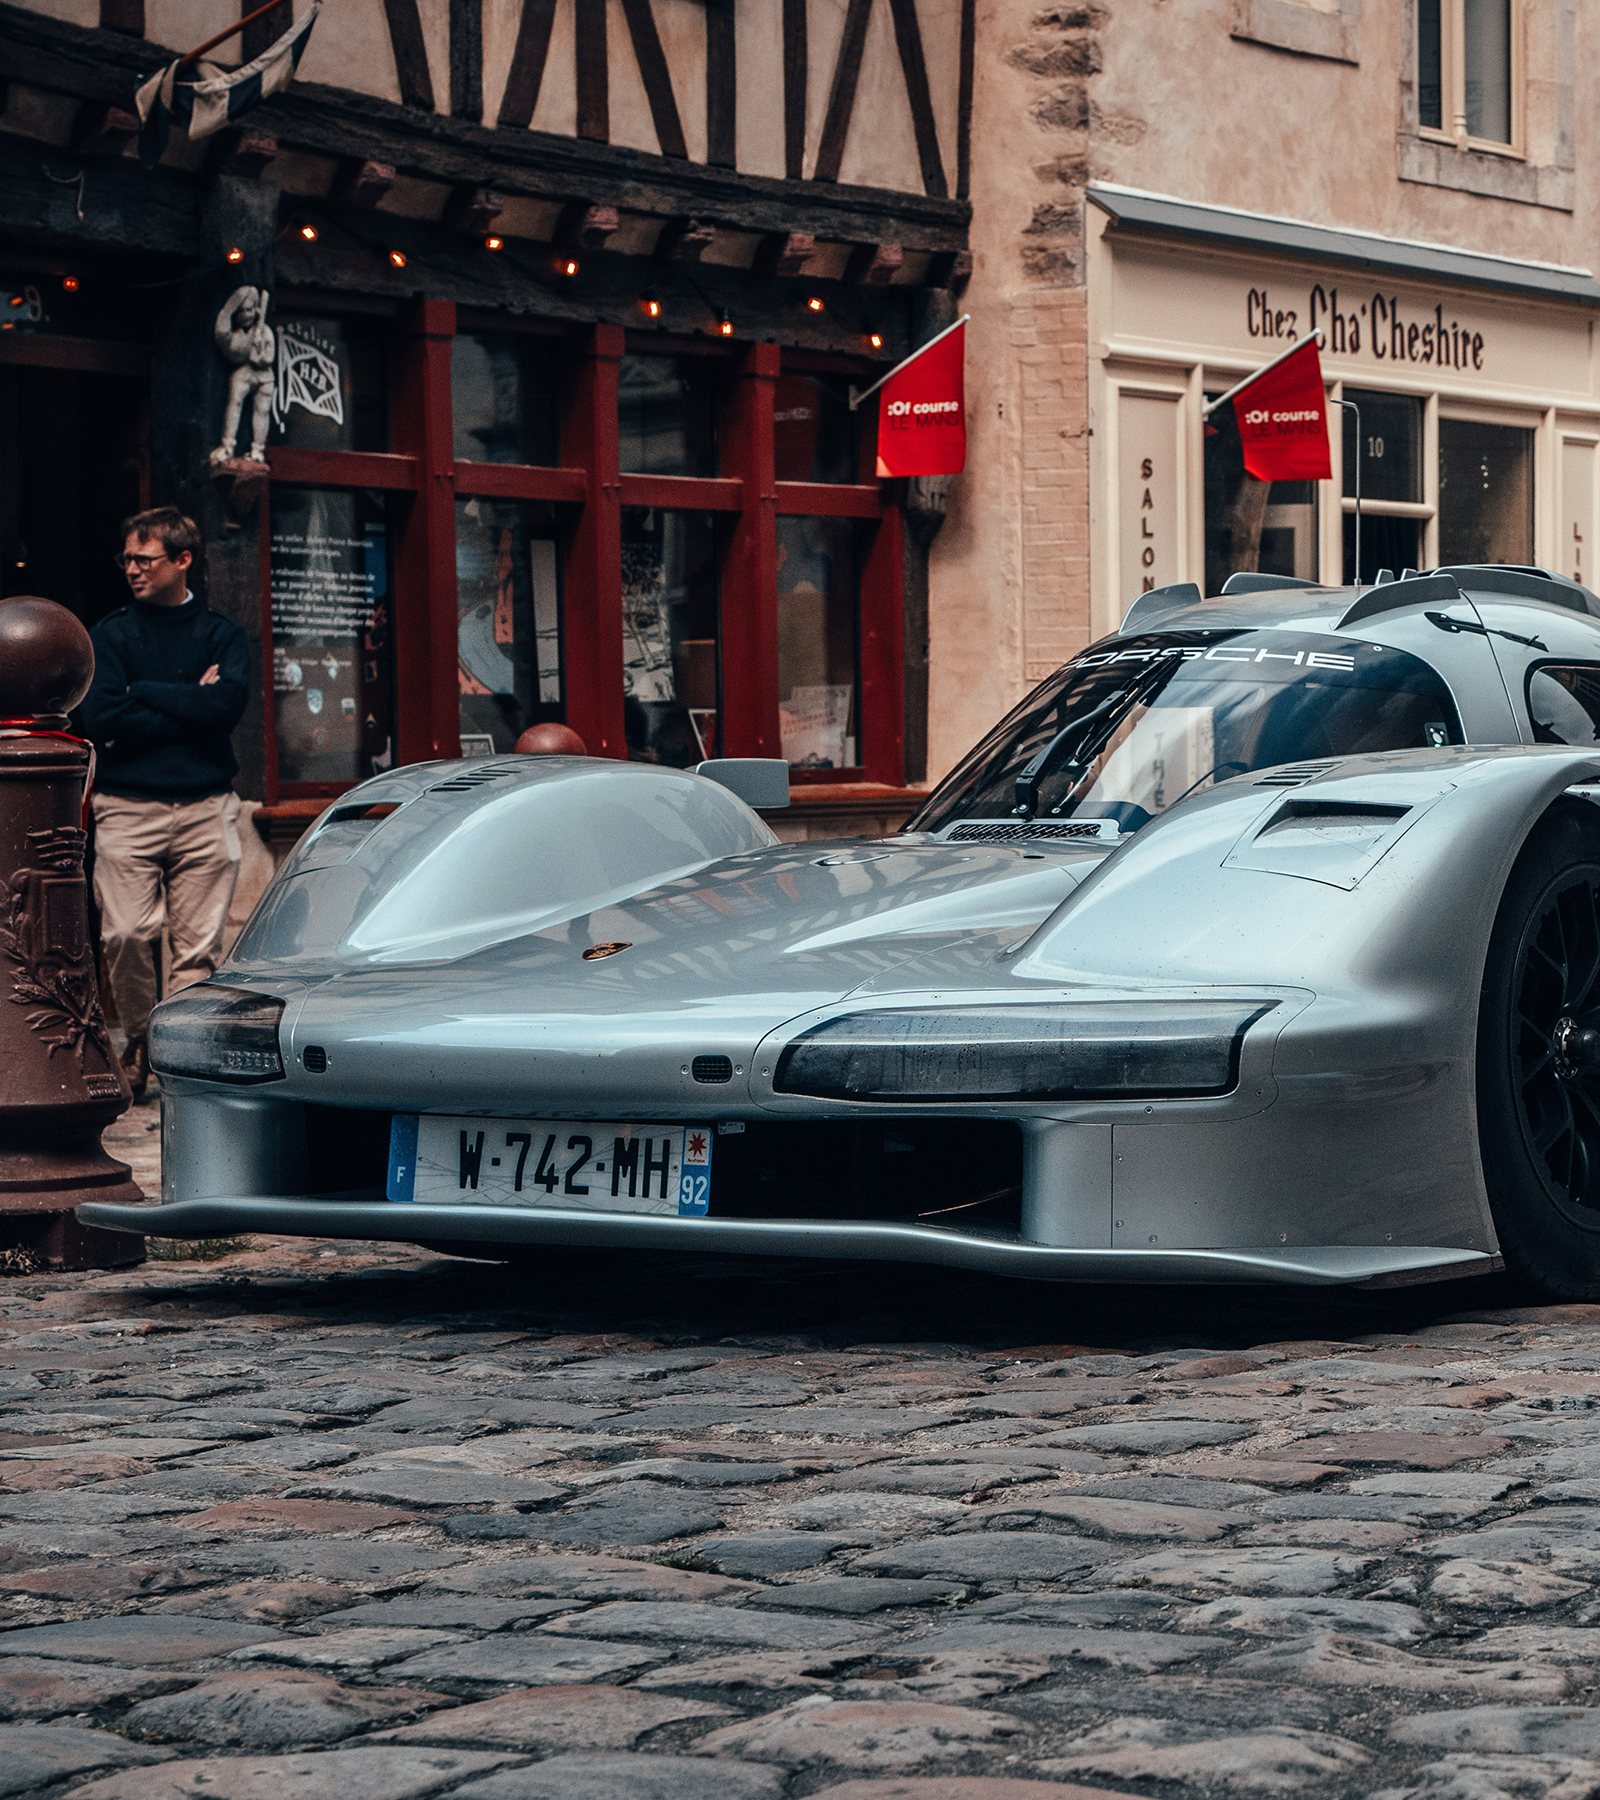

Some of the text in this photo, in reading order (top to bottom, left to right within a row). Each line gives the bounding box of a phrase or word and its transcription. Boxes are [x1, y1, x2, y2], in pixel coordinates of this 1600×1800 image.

[1247, 287, 1298, 341] Chez
[913, 401, 959, 414] course
[1272, 410, 1319, 422] course
[890, 411, 959, 431] LE MANS
[1251, 420, 1320, 438] LE MANS
[1368, 437, 1384, 458] 10
[1141, 458, 1154, 594] SALON
[397, 1166, 404, 1183] F
[681, 1175, 708, 1205] 92
